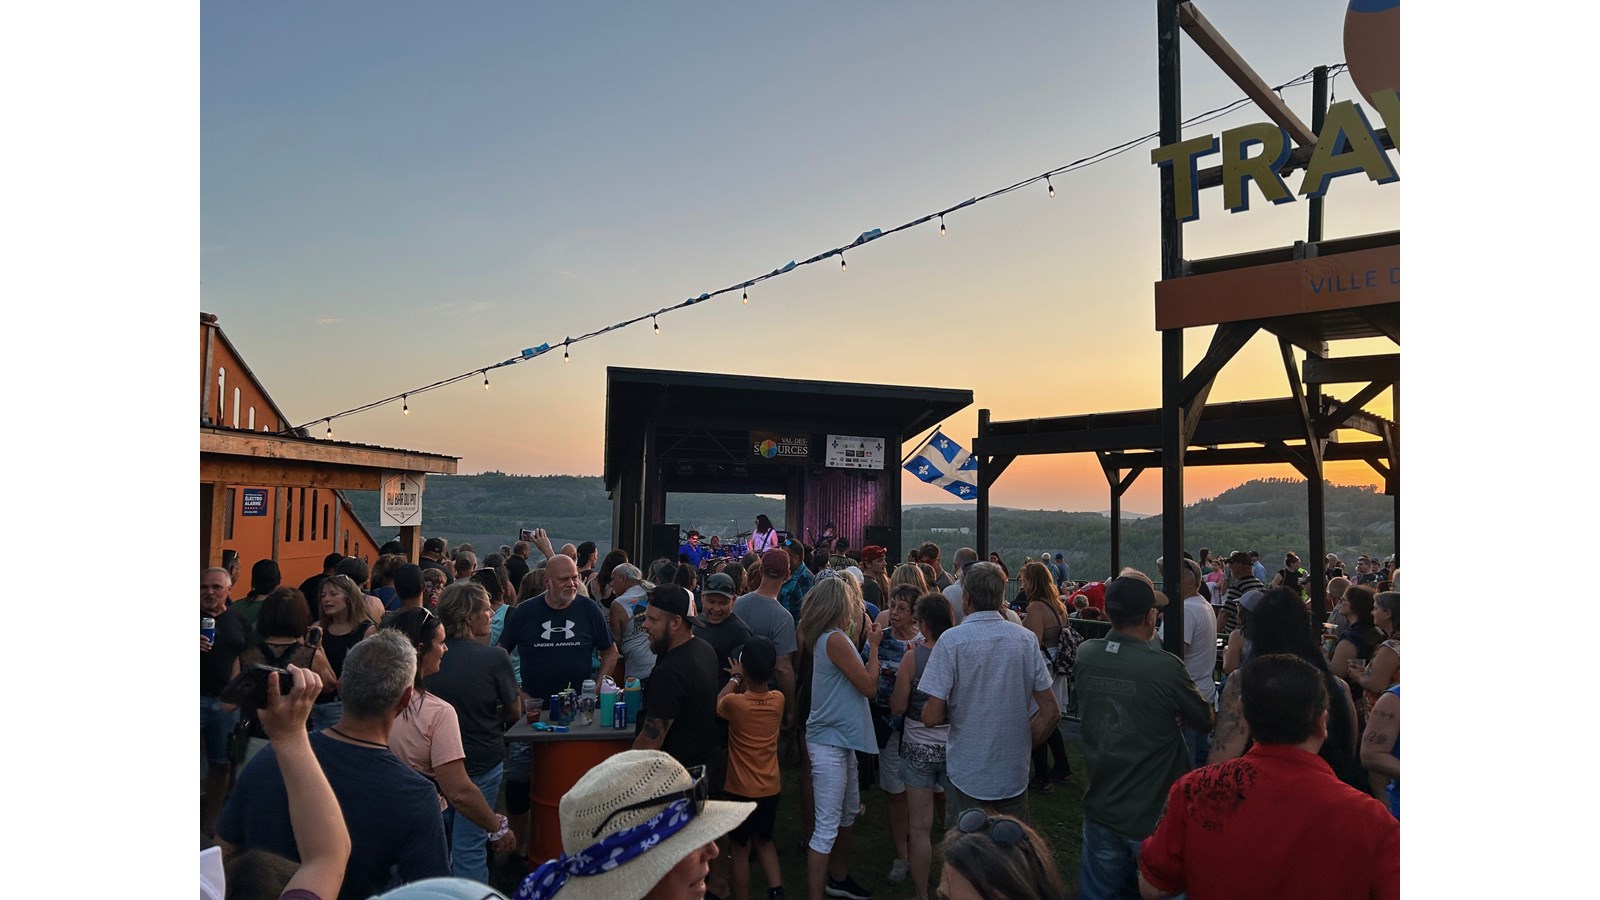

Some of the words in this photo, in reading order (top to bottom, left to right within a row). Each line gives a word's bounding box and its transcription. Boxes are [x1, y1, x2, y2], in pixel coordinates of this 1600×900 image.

[1309, 270, 1377, 294] VILLE
[395, 492, 404, 506] BAR
[404, 493, 410, 506] DU
